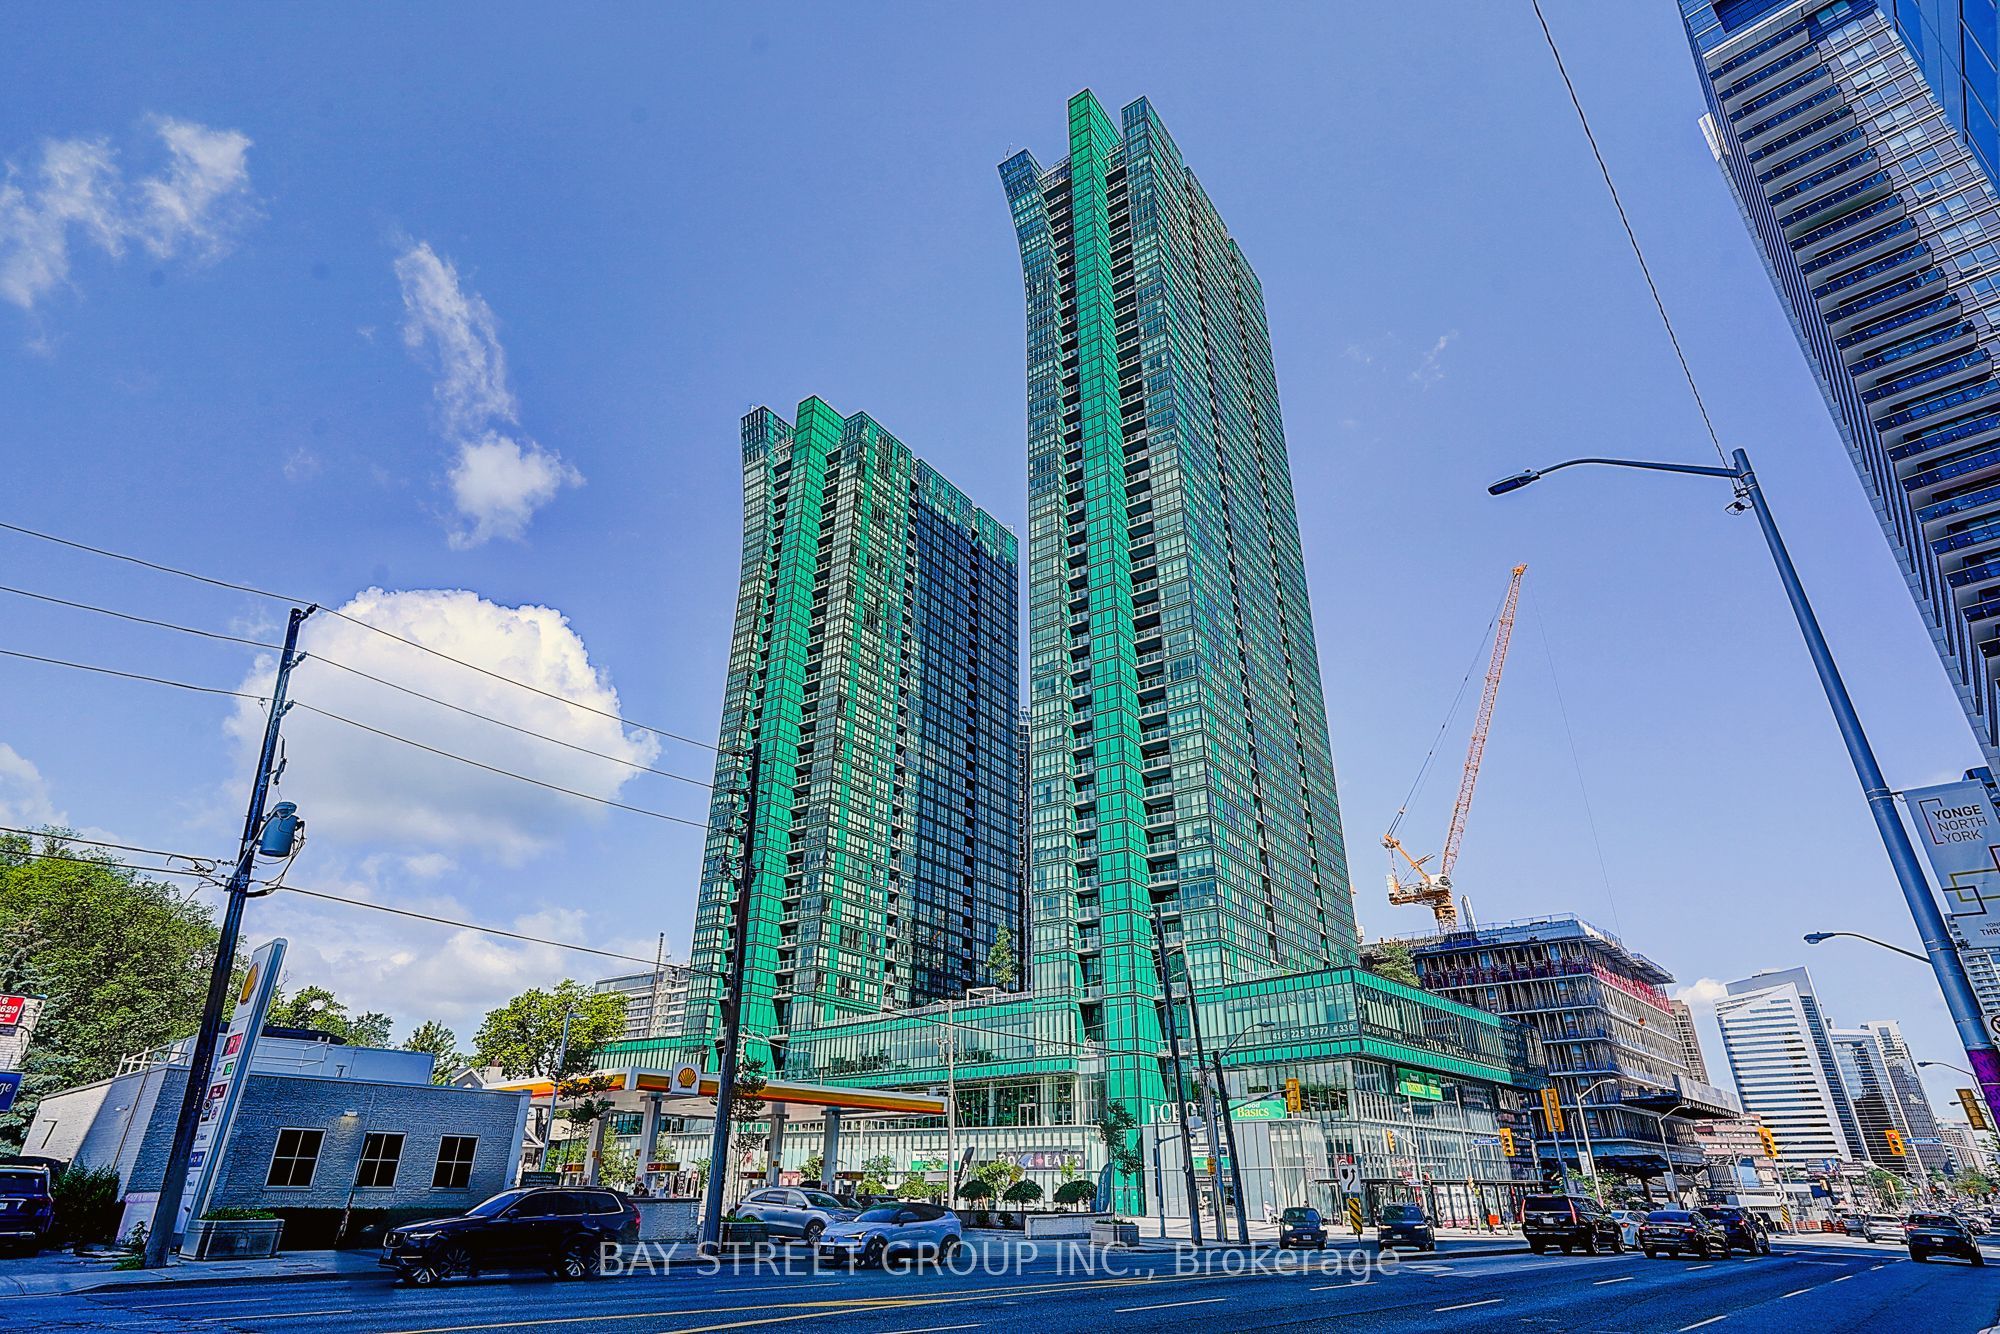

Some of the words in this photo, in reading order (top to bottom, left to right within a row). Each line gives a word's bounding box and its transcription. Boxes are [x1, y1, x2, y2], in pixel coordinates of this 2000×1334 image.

[1932, 805, 1982, 820] YONGE
[1937, 816, 1988, 832] NORTH
[1942, 829, 1983, 844] YORK
[1272, 1031, 1287, 1040] 416
[1291, 1029, 1305, 1038] 225
[1309, 1026, 1328, 1036] 9777
[1333, 1024, 1354, 1033] #330
[1498, 1088, 1520, 1112] LCBO
[1237, 1106, 1270, 1118] Basics
[997, 1153, 1034, 1168] POE
[1044, 1154, 1082, 1168] EATS
